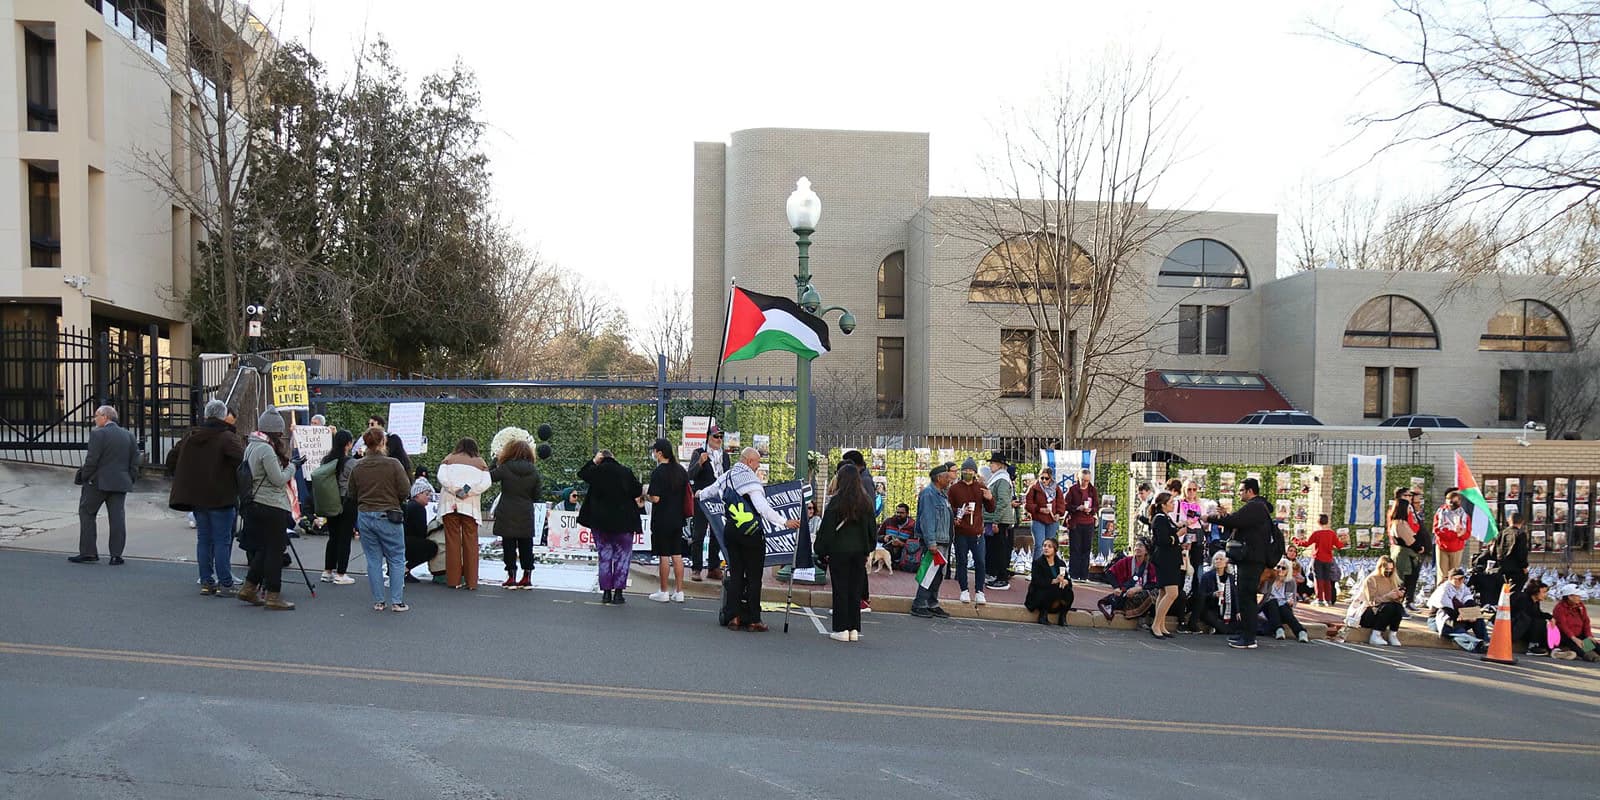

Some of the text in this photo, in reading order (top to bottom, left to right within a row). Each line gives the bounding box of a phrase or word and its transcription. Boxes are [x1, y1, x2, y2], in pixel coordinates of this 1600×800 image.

[273, 365, 289, 373] Free
[273, 373, 305, 382] Palestine
[288, 384, 306, 392] GAZA
[279, 393, 303, 404] LIVE!
[560, 515, 578, 529] STO
